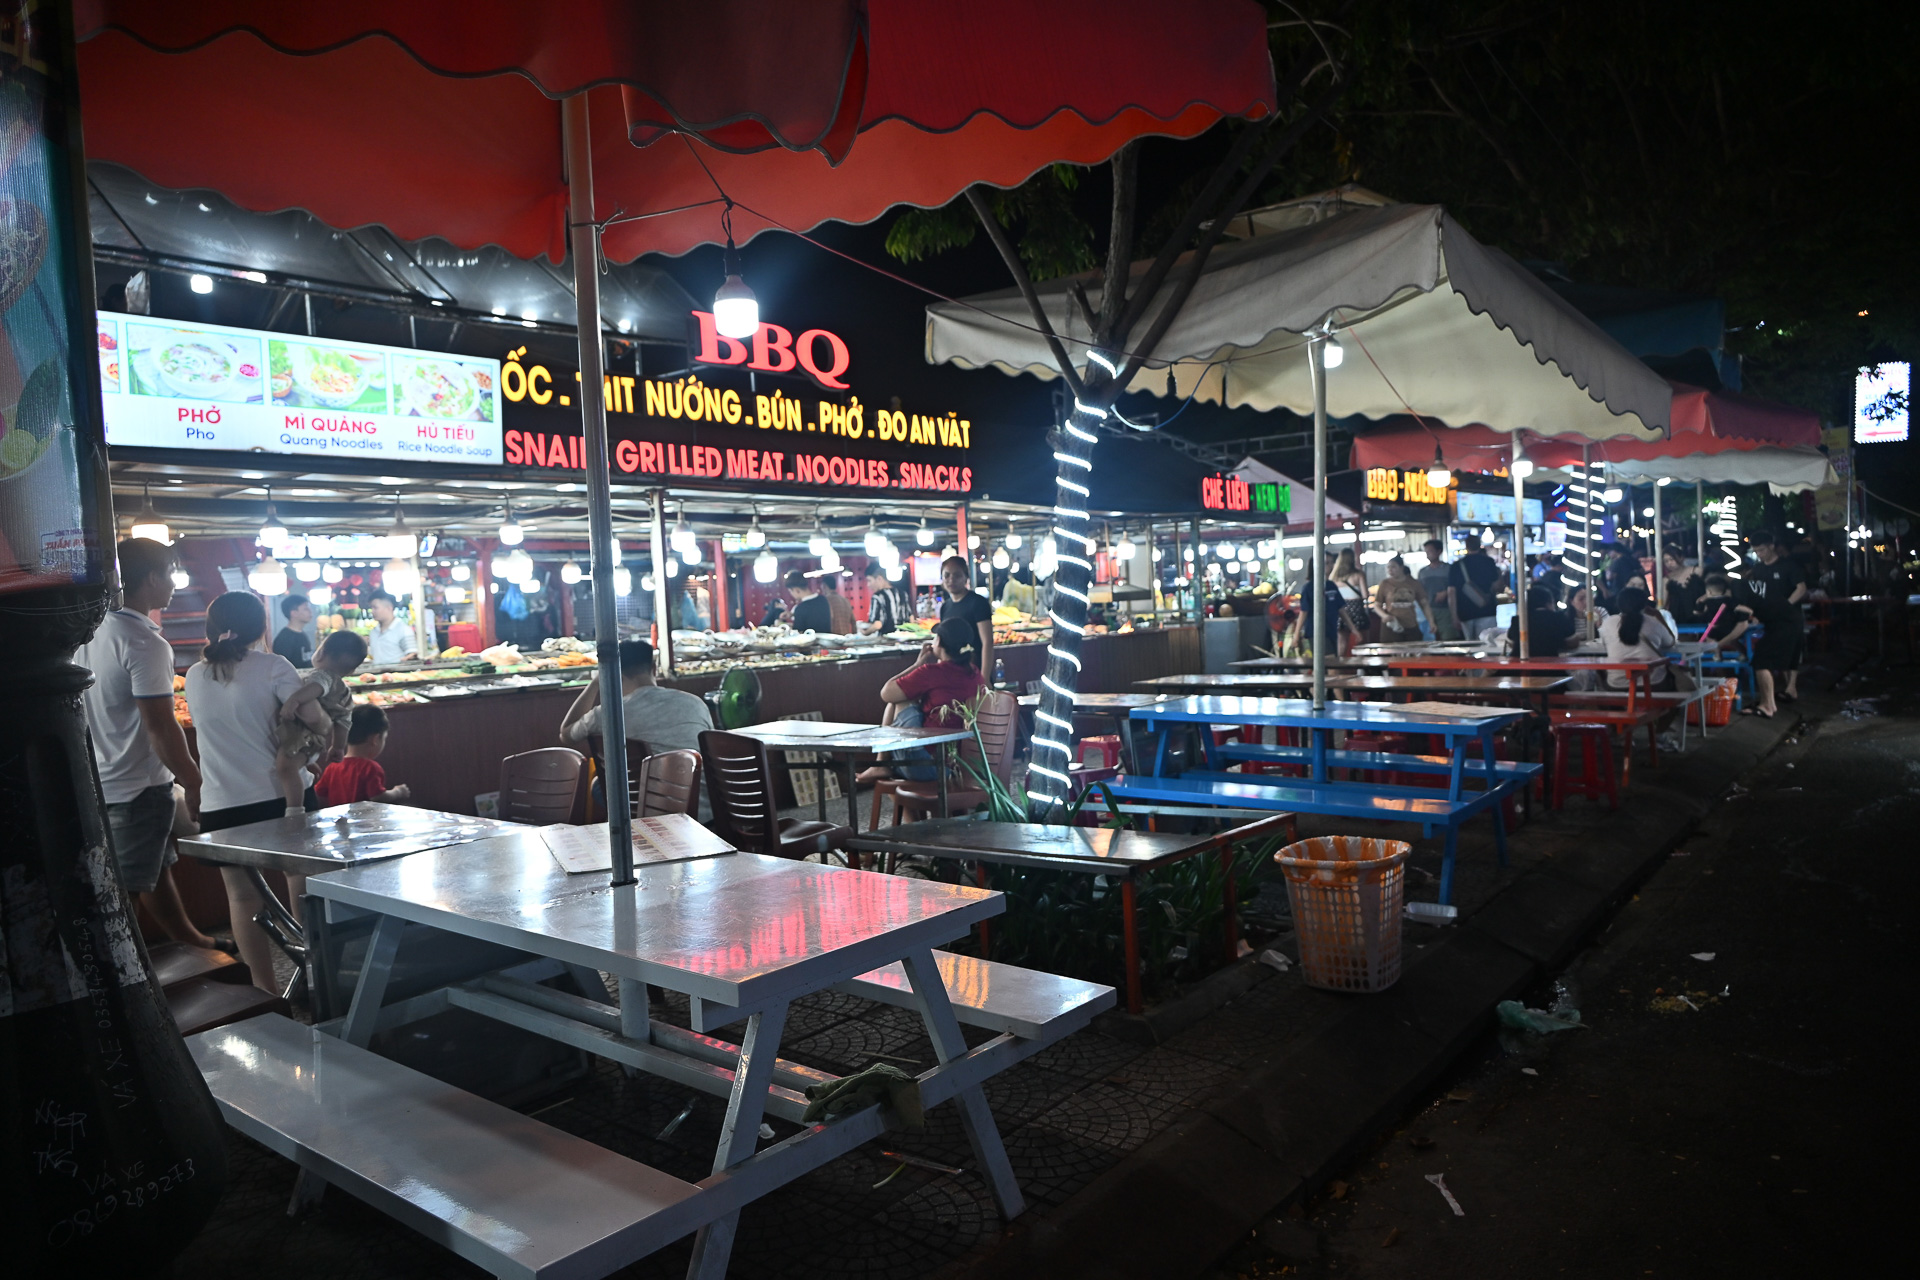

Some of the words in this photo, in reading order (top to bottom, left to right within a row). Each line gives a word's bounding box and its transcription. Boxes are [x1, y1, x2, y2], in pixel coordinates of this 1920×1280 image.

[692, 310, 851, 390] BBQ
[501, 346, 553, 406] ỐC
[645, 375, 741, 426] NƯỚNG
[756, 389, 803, 433] BÚN
[820, 396, 864, 440] PHỞ
[178, 405, 222, 425] PHỞ
[284, 412, 306, 430] MÌ
[311, 415, 378, 435] QUẢNG
[186, 427, 216, 441] Pho
[279, 432, 328, 449] Quang
[331, 434, 384, 450] Noodles
[417, 421, 438, 439] HỦ
[443, 424, 475, 441] TIẾU
[398, 440, 422, 452] Rice
[425, 442, 463, 455] Noodle
[466, 444, 493, 457] Soup
[616, 439, 724, 478] GRILLED
[726, 446, 785, 482] MEAT
[796, 453, 890, 488] NOODLES
[900, 461, 973, 493] SNACKS
[1367, 467, 1398, 502] BBQ
